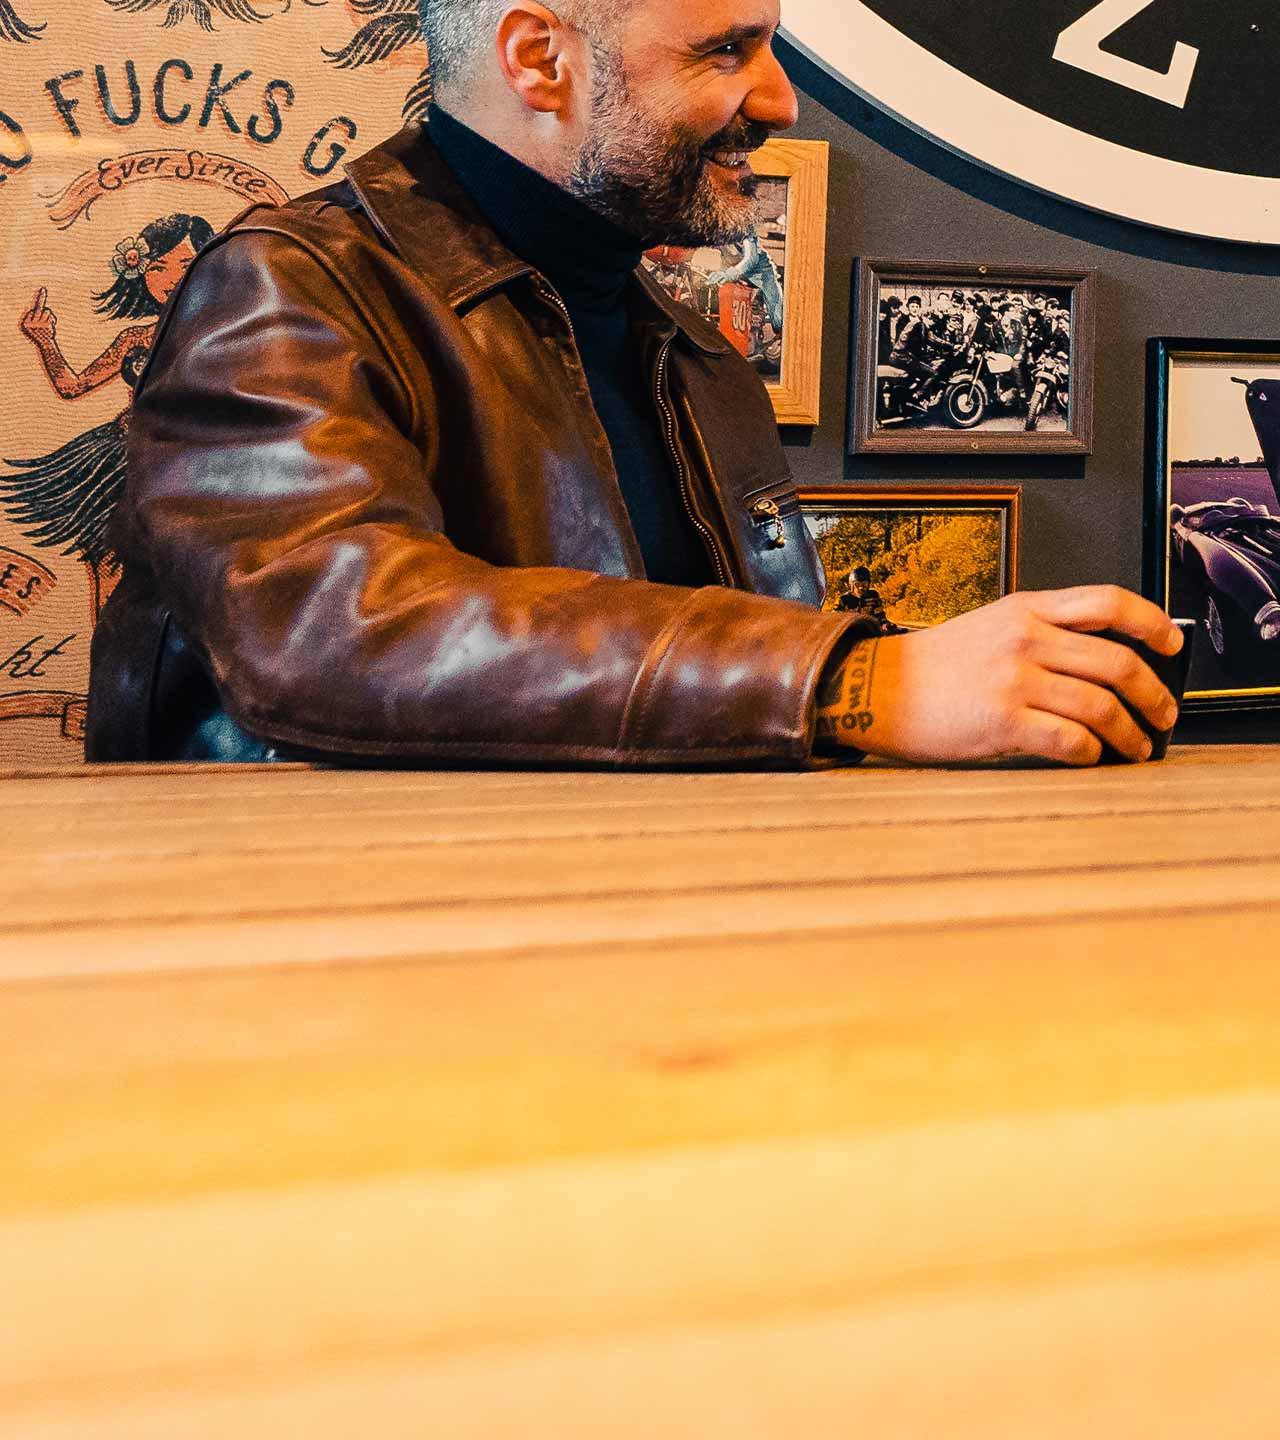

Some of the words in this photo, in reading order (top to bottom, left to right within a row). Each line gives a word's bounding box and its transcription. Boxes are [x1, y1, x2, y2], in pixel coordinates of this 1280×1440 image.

[45, 59, 295, 143] FUCKS
[98, 157, 167, 190] Ever
[174, 150, 268, 194] Since
